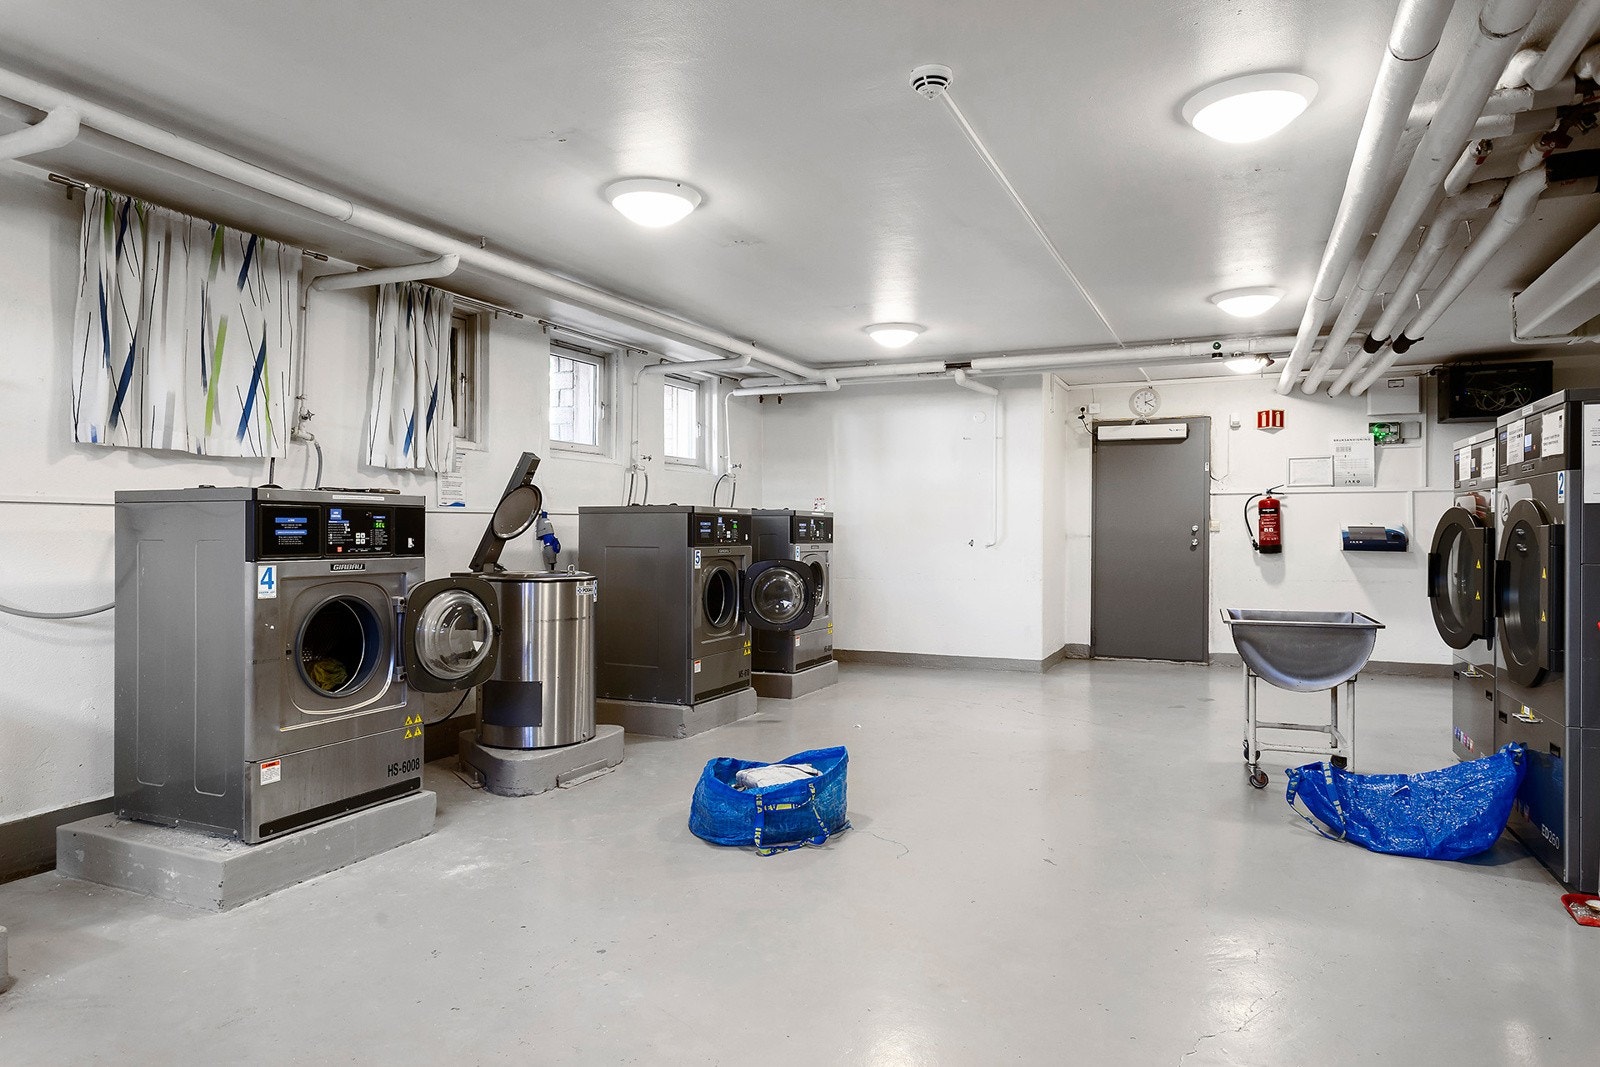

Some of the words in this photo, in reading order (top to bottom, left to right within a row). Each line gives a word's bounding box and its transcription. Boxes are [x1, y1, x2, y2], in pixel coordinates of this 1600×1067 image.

[1558, 473, 1564, 495] 2
[695, 551, 701, 564] 5
[260, 567, 274, 590] 4
[387, 757, 420, 777] HS-6008
[1541, 823, 1560, 850] ED260
